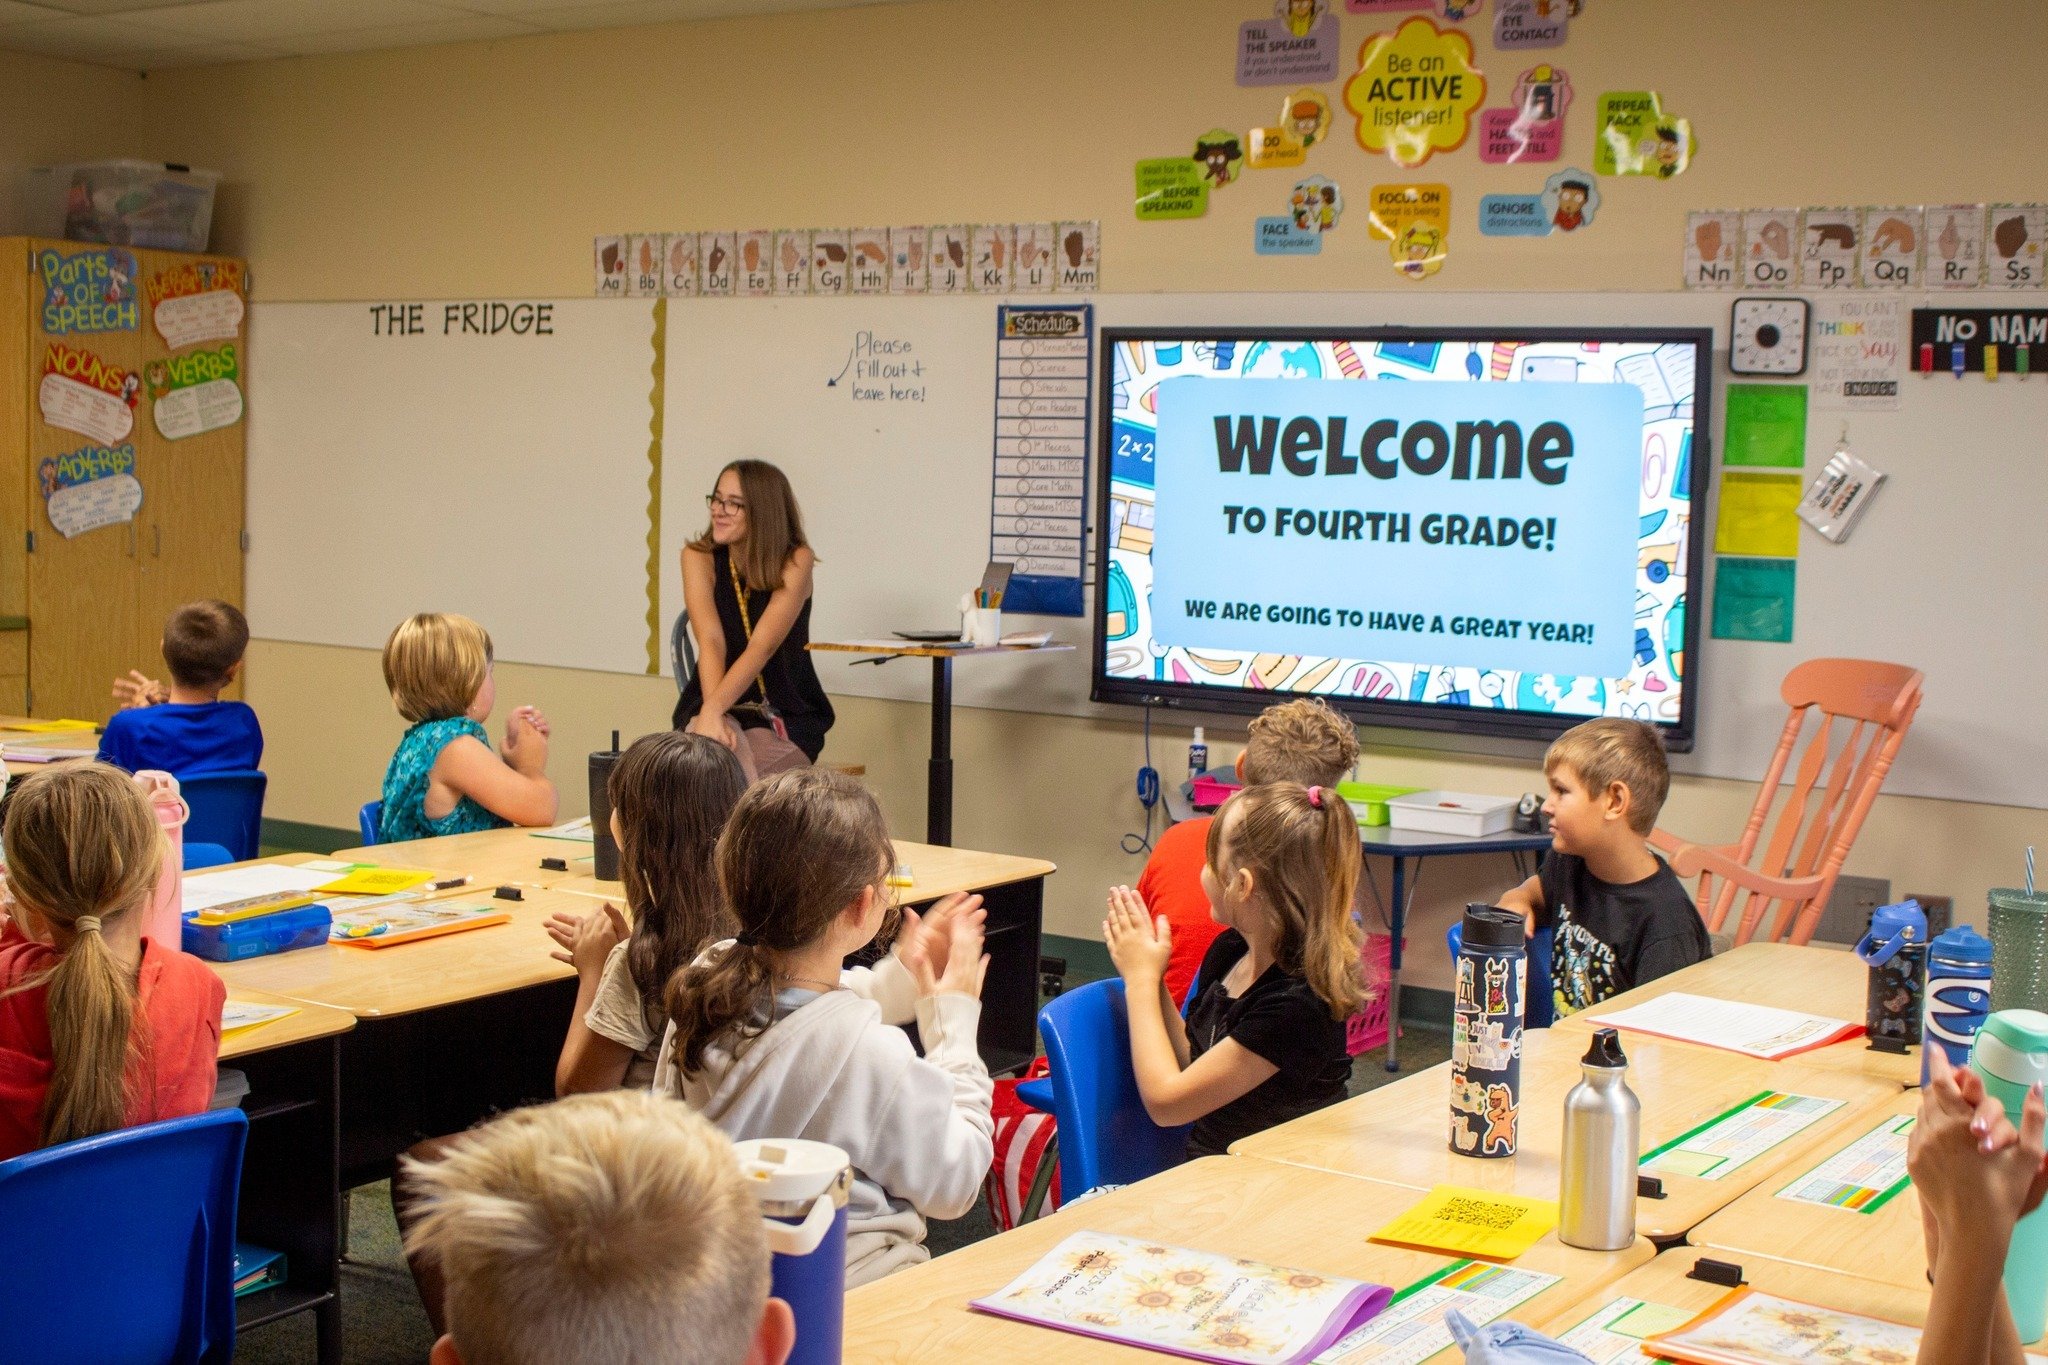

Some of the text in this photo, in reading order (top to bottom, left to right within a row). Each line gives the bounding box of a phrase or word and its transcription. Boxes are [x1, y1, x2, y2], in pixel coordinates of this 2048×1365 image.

[1502, 15, 1523, 27] EYE
[1245, 29, 1268, 40] TELL
[1502, 27, 1559, 41] CONTACT
[1245, 38, 1317, 53] THE SPEAKER
[1252, 57, 1268, 66] you
[1270, 51, 1322, 63] understand
[1387, 54, 1444, 73] Be an
[1278, 61, 1331, 74] understand
[1367, 74, 1463, 102] ACTIVE
[1607, 99, 1652, 111] REPEAT
[1373, 105, 1453, 126] listener!
[1488, 143, 1547, 154] FEET TILL
[1163, 187, 1200, 199] BEFORE
[1421, 192, 1441, 203] ON
[1142, 200, 1193, 213] SPEAKING
[1379, 206, 1441, 218] what is being
[1487, 203, 1535, 215] IGNORE
[1262, 224, 1289, 236] FACE
[1486, 217, 1543, 228] distractions
[1262, 239, 1314, 250] the speaker
[42, 253, 109, 289] Parts
[1700, 261, 2031, 284] Nn Oo Pp Qq Rr Ss
[602, 268, 1094, 291] Aa Bb Cc Dd Ee Ff Gg Hh Ii Jj Kk Ll Mm
[73, 282, 102, 305] OF
[45, 302, 136, 333] SPEECH
[370, 302, 554, 335] THE FRIDGE
[1015, 316, 1074, 333] Schedule
[1816, 321, 1866, 336] THINK
[1936, 315, 1978, 343] NO
[855, 330, 913, 357] Please
[45, 344, 124, 390] NOUNS
[166, 345, 236, 384] VERBS
[856, 359, 880, 379] fill
[882, 361, 907, 379] out
[852, 381, 926, 403] leave here!
[1844, 381, 1898, 396] ENOUGH
[1033, 420, 1060, 433] Lunch
[1044, 439, 1072, 453] Recess
[57, 445, 133, 481] ADVERBS
[1031, 460, 1056, 472] Math
[1051, 480, 1073, 492] Math
[1223, 505, 1266, 535] TO
[1336, 609, 1364, 628] TO
[1430, 615, 1445, 634] A
[1472, 1025, 1488, 1035] JUST
[1042, 1249, 1106, 1297] Parent-Teacher
[1075, 1264, 1118, 1296] 2025-26
[1186, 1276, 1250, 1331] Communication
